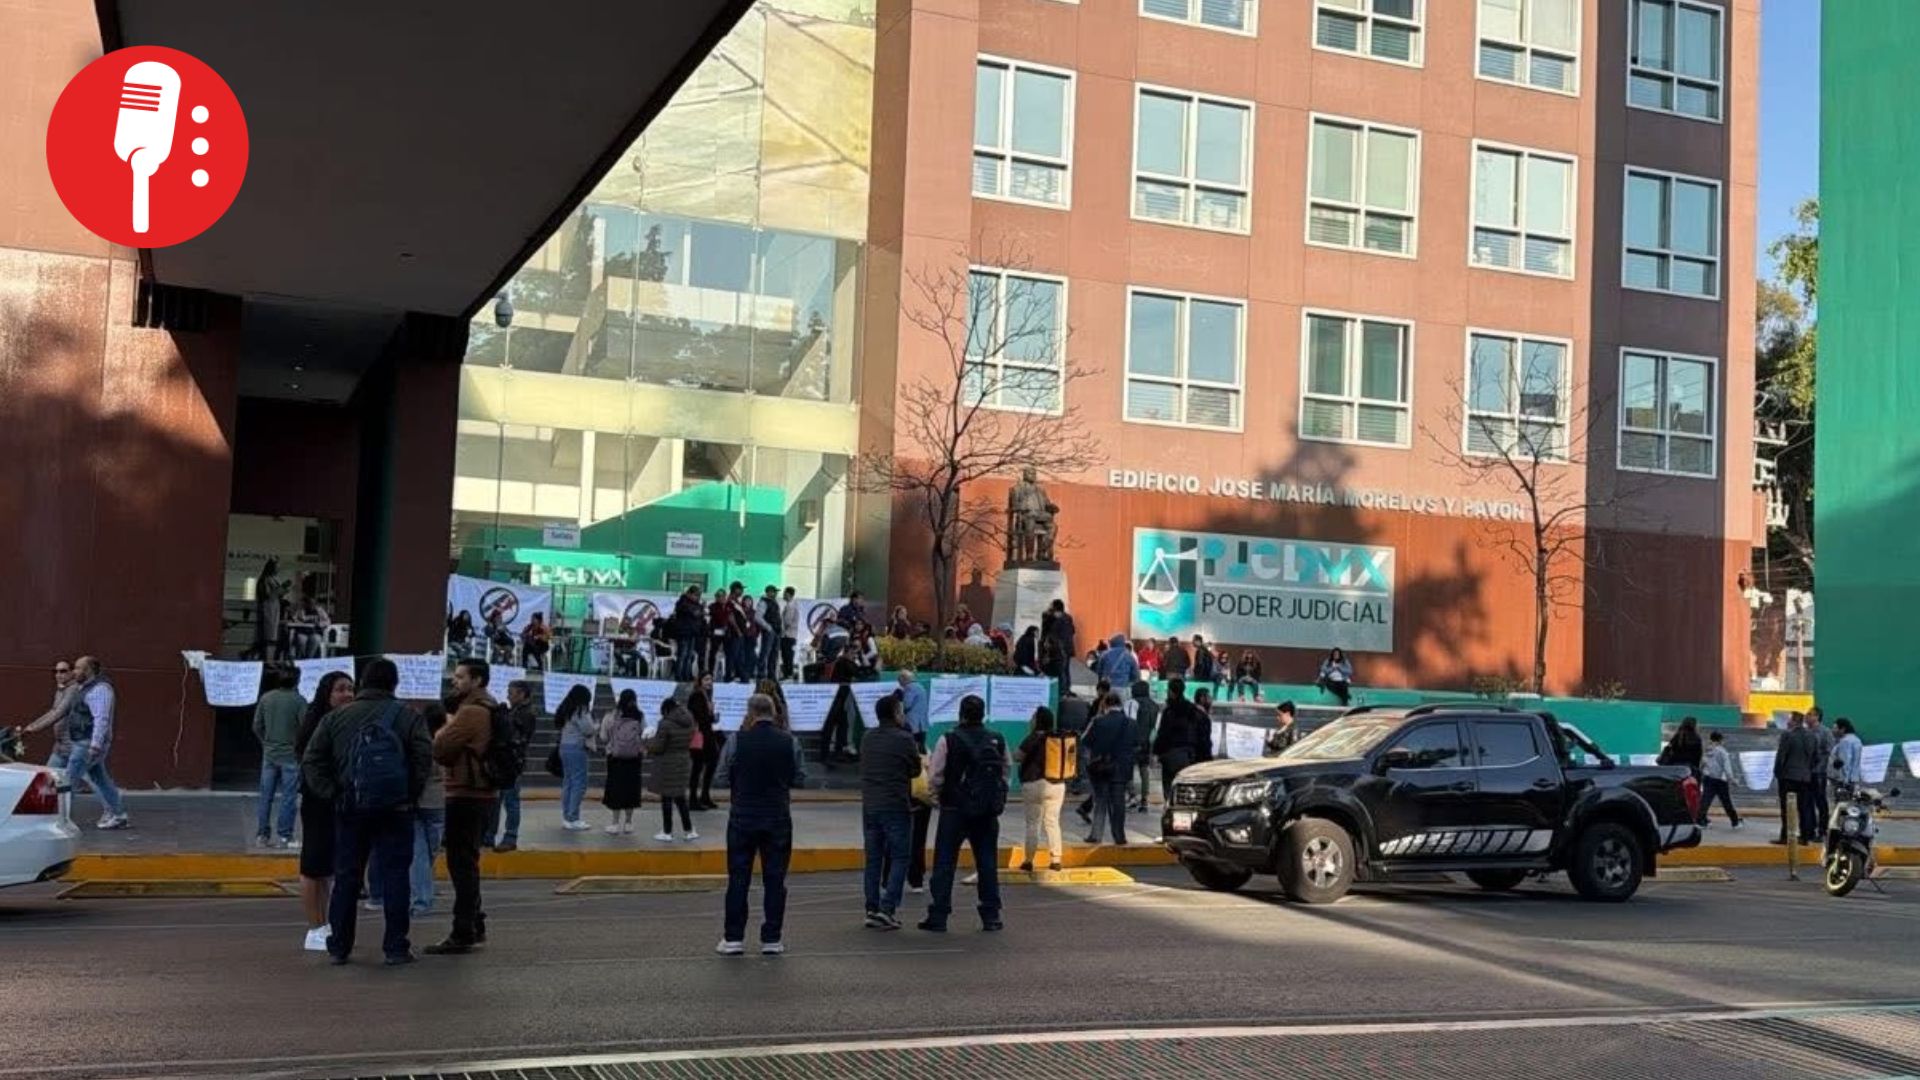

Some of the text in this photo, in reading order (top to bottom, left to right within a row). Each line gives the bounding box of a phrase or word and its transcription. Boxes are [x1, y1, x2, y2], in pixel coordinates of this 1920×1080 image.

[1110, 470, 1200, 494] EDIFICIO
[1269, 482, 1336, 505] MARÍA
[1344, 488, 1439, 514] MORELOS
[1441, 496, 1457, 515] Y
[1202, 592, 1388, 624] PODER JUDICIAL
